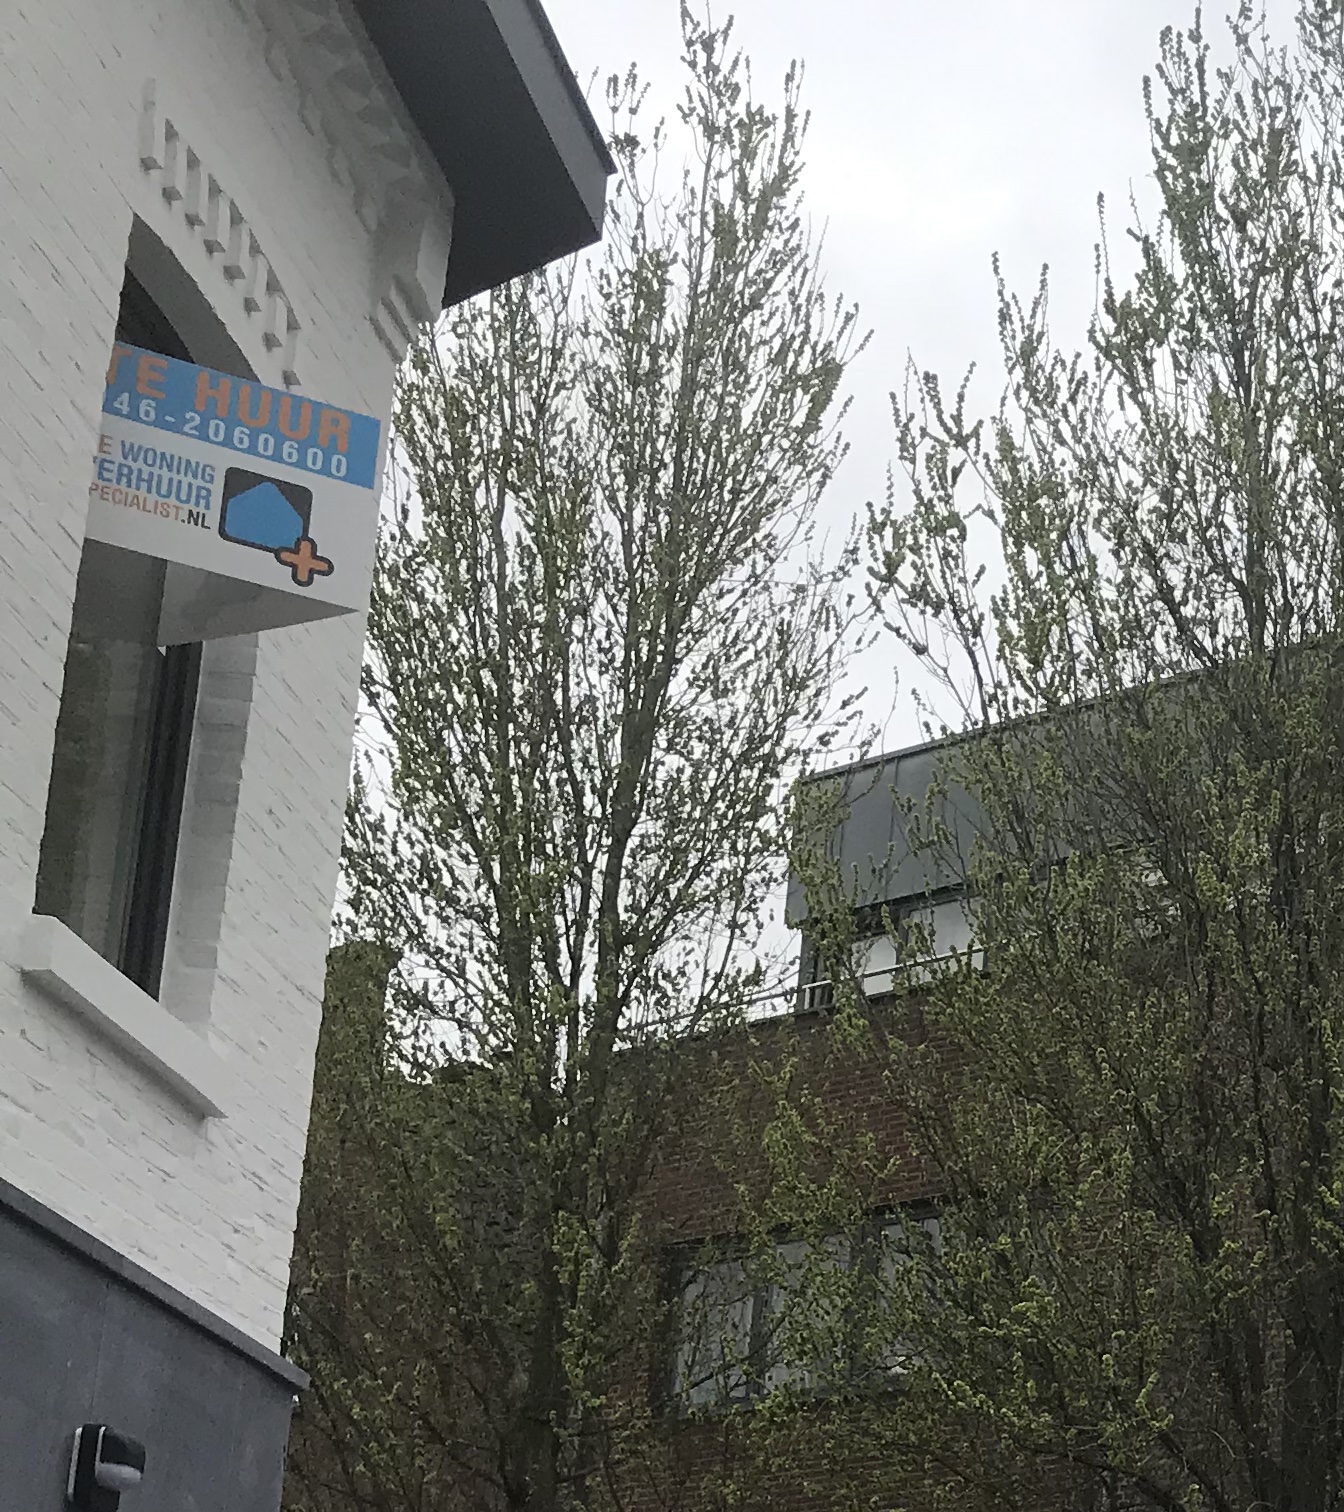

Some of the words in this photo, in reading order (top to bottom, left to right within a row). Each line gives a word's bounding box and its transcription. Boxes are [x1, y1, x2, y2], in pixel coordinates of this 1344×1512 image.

[113, 391, 348, 478] 46-2060600
[194, 370, 351, 454] HUUR
[93, 455, 212, 511] ERHUUR
[120, 440, 216, 485] WONING
